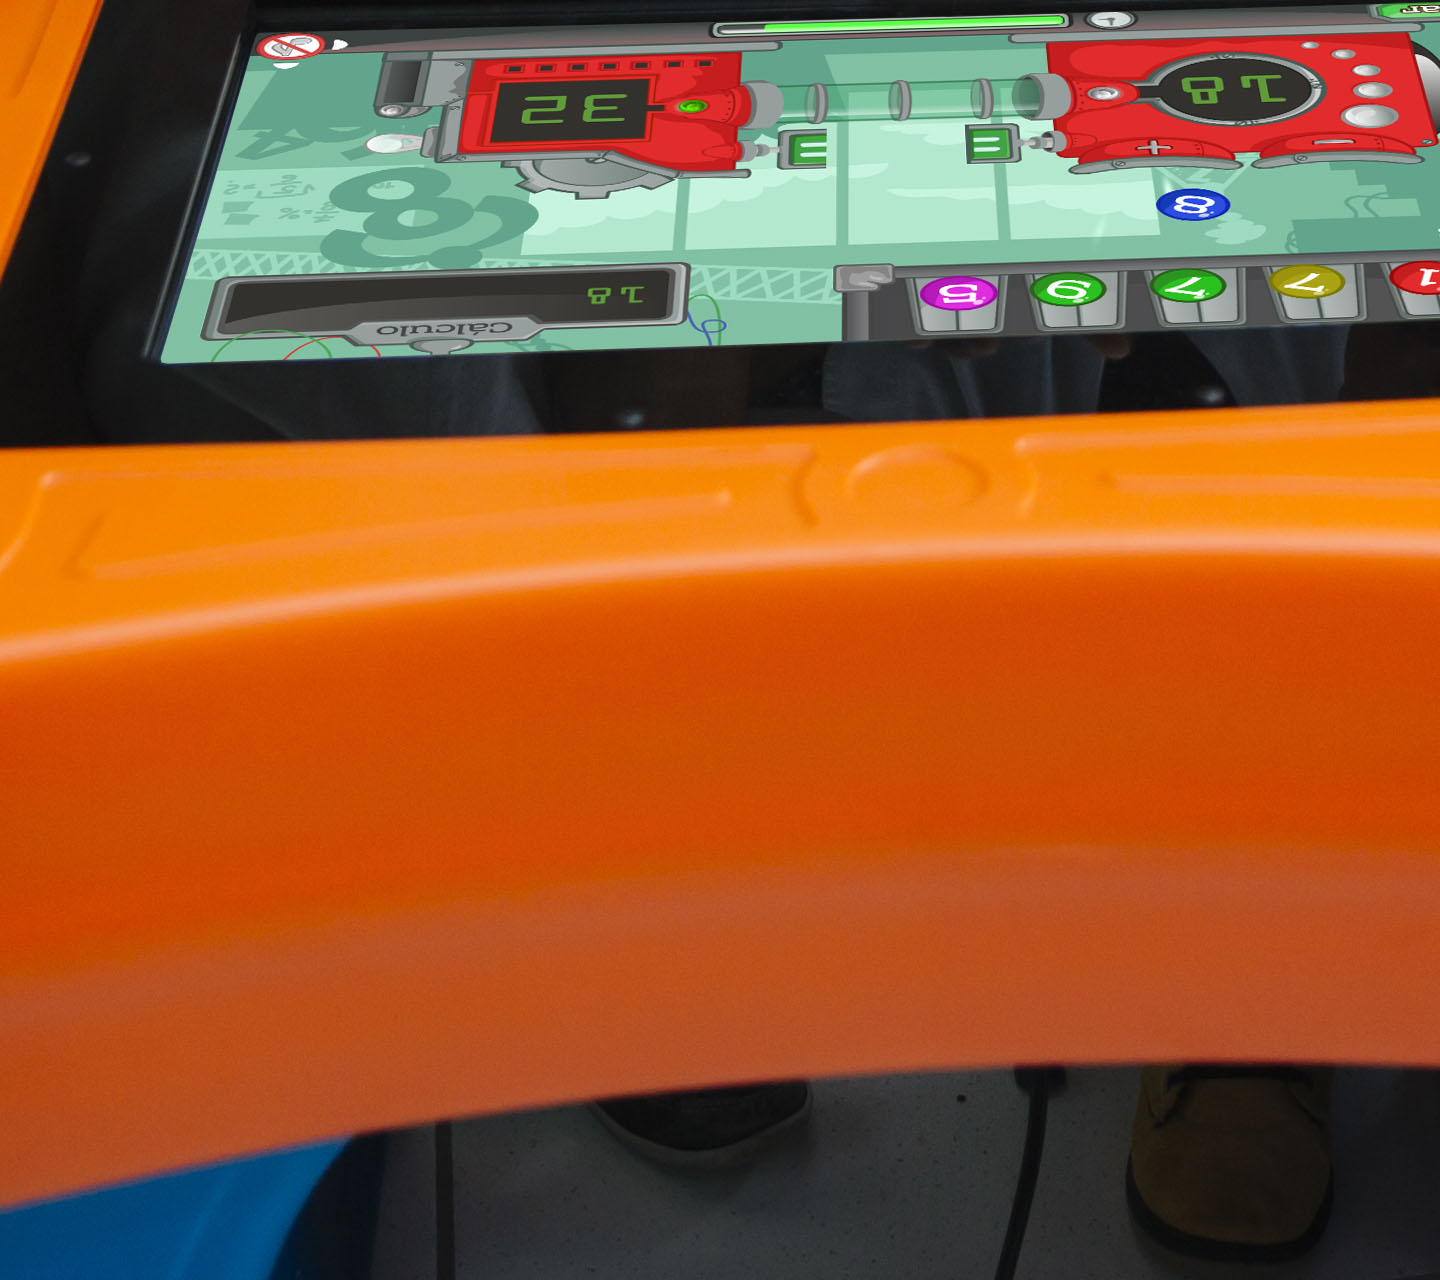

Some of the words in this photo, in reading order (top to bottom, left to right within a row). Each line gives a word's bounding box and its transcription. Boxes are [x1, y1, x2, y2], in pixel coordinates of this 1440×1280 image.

[1180, 74, 1289, 105] 18
[519, 93, 630, 126] 32
[1173, 194, 1215, 217] 8
[1168, 275, 1209, 296] 7
[1286, 271, 1327, 293] 7
[586, 284, 647, 306] 18
[938, 283, 981, 305] 5
[375, 318, 514, 341] Cálculo
